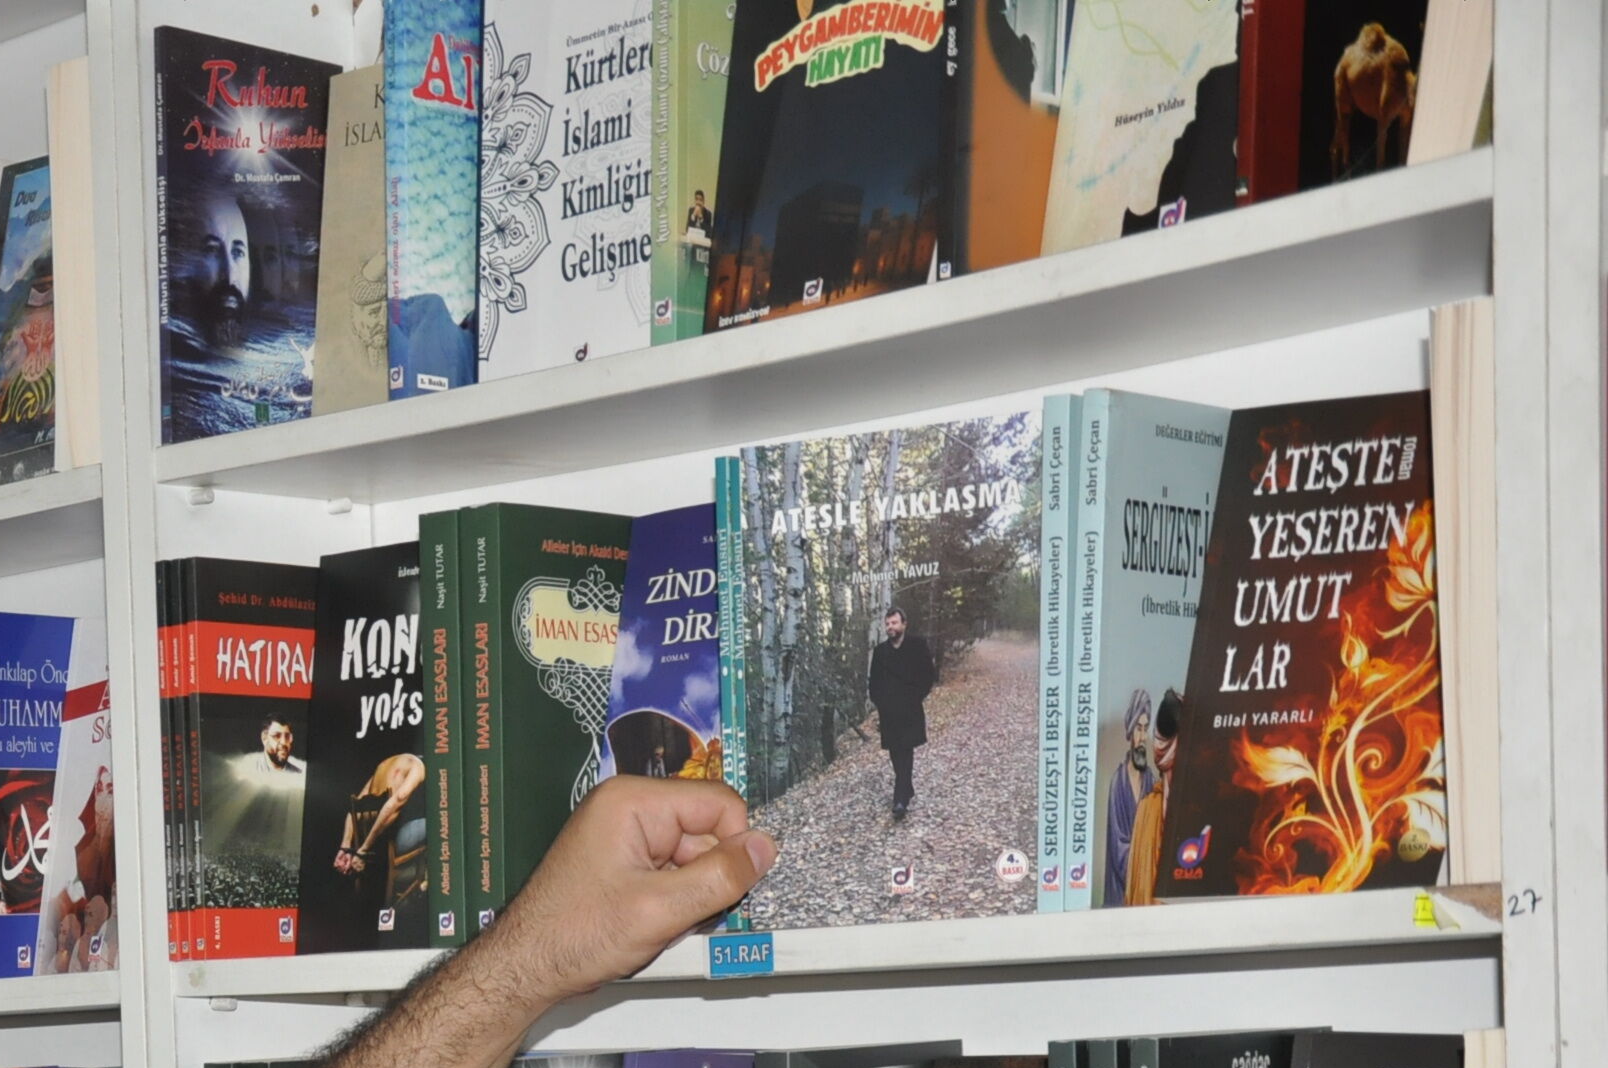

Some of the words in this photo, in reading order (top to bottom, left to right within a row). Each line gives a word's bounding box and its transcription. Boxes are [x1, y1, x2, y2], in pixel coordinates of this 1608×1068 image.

[755, 0, 946, 89] PEYGAMBERİMİN
[806, 35, 884, 84] HAYATI
[946, 25, 958, 56] gece
[202, 58, 308, 111] Ruhun
[562, 98, 633, 158] İslami
[1114, 106, 1155, 129] Hüseyin
[160, 280, 170, 324] Ruhun
[1048, 426, 1064, 470] Çeçan
[1155, 422, 1190, 442] DEĞERLER
[1192, 427, 1223, 448] EĞİTİMİ
[1398, 436, 1417, 481] roman
[1254, 436, 1400, 498] ATEŞTE
[771, 501, 861, 535] ATEŞLE
[874, 477, 1023, 519] YAKLAŞMA
[1048, 473, 1061, 512] Sabri
[717, 527, 728, 582] Ensari
[1248, 502, 1414, 563] YEŞEREN
[434, 543, 445, 579] TUTAR
[902, 561, 940, 578] YAVUZ
[1047, 535, 1062, 613] Hikayeler)
[1081, 531, 1099, 609] Hikayeler)
[218, 591, 248, 606] Şehid
[435, 580, 448, 609] Naşit
[1234, 570, 1352, 628] UMUT
[536, 611, 579, 642] İMAN
[718, 589, 731, 657] Mehmet
[1047, 615, 1061, 678] (İbretlik
[1079, 610, 1095, 674] (İbretlik
[216, 636, 316, 688] HATIRA
[432, 627, 448, 703] ESASLARI
[474, 621, 490, 698] ESASLARI
[660, 652, 690, 664] ROMAN
[1219, 641, 1292, 693] LAR
[433, 707, 449, 754] İMAN
[475, 703, 491, 749] İMAN
[1044, 686, 1062, 741] BEŞER
[1075, 682, 1093, 738] BEŞER
[1213, 714, 1247, 729] Bilal
[1250, 708, 1313, 727] YARARLI
[6, 736, 37, 763] aleyhi
[40, 739, 54, 753] ve
[1043, 746, 1062, 857] SERGÜZEŞT-İ
[1071, 743, 1091, 855] SERGÜZEŞT-İ
[1006, 852, 1020, 865] 4.
[1507, 888, 1542, 918] 27
[713, 944, 770, 965] 51.RAF
